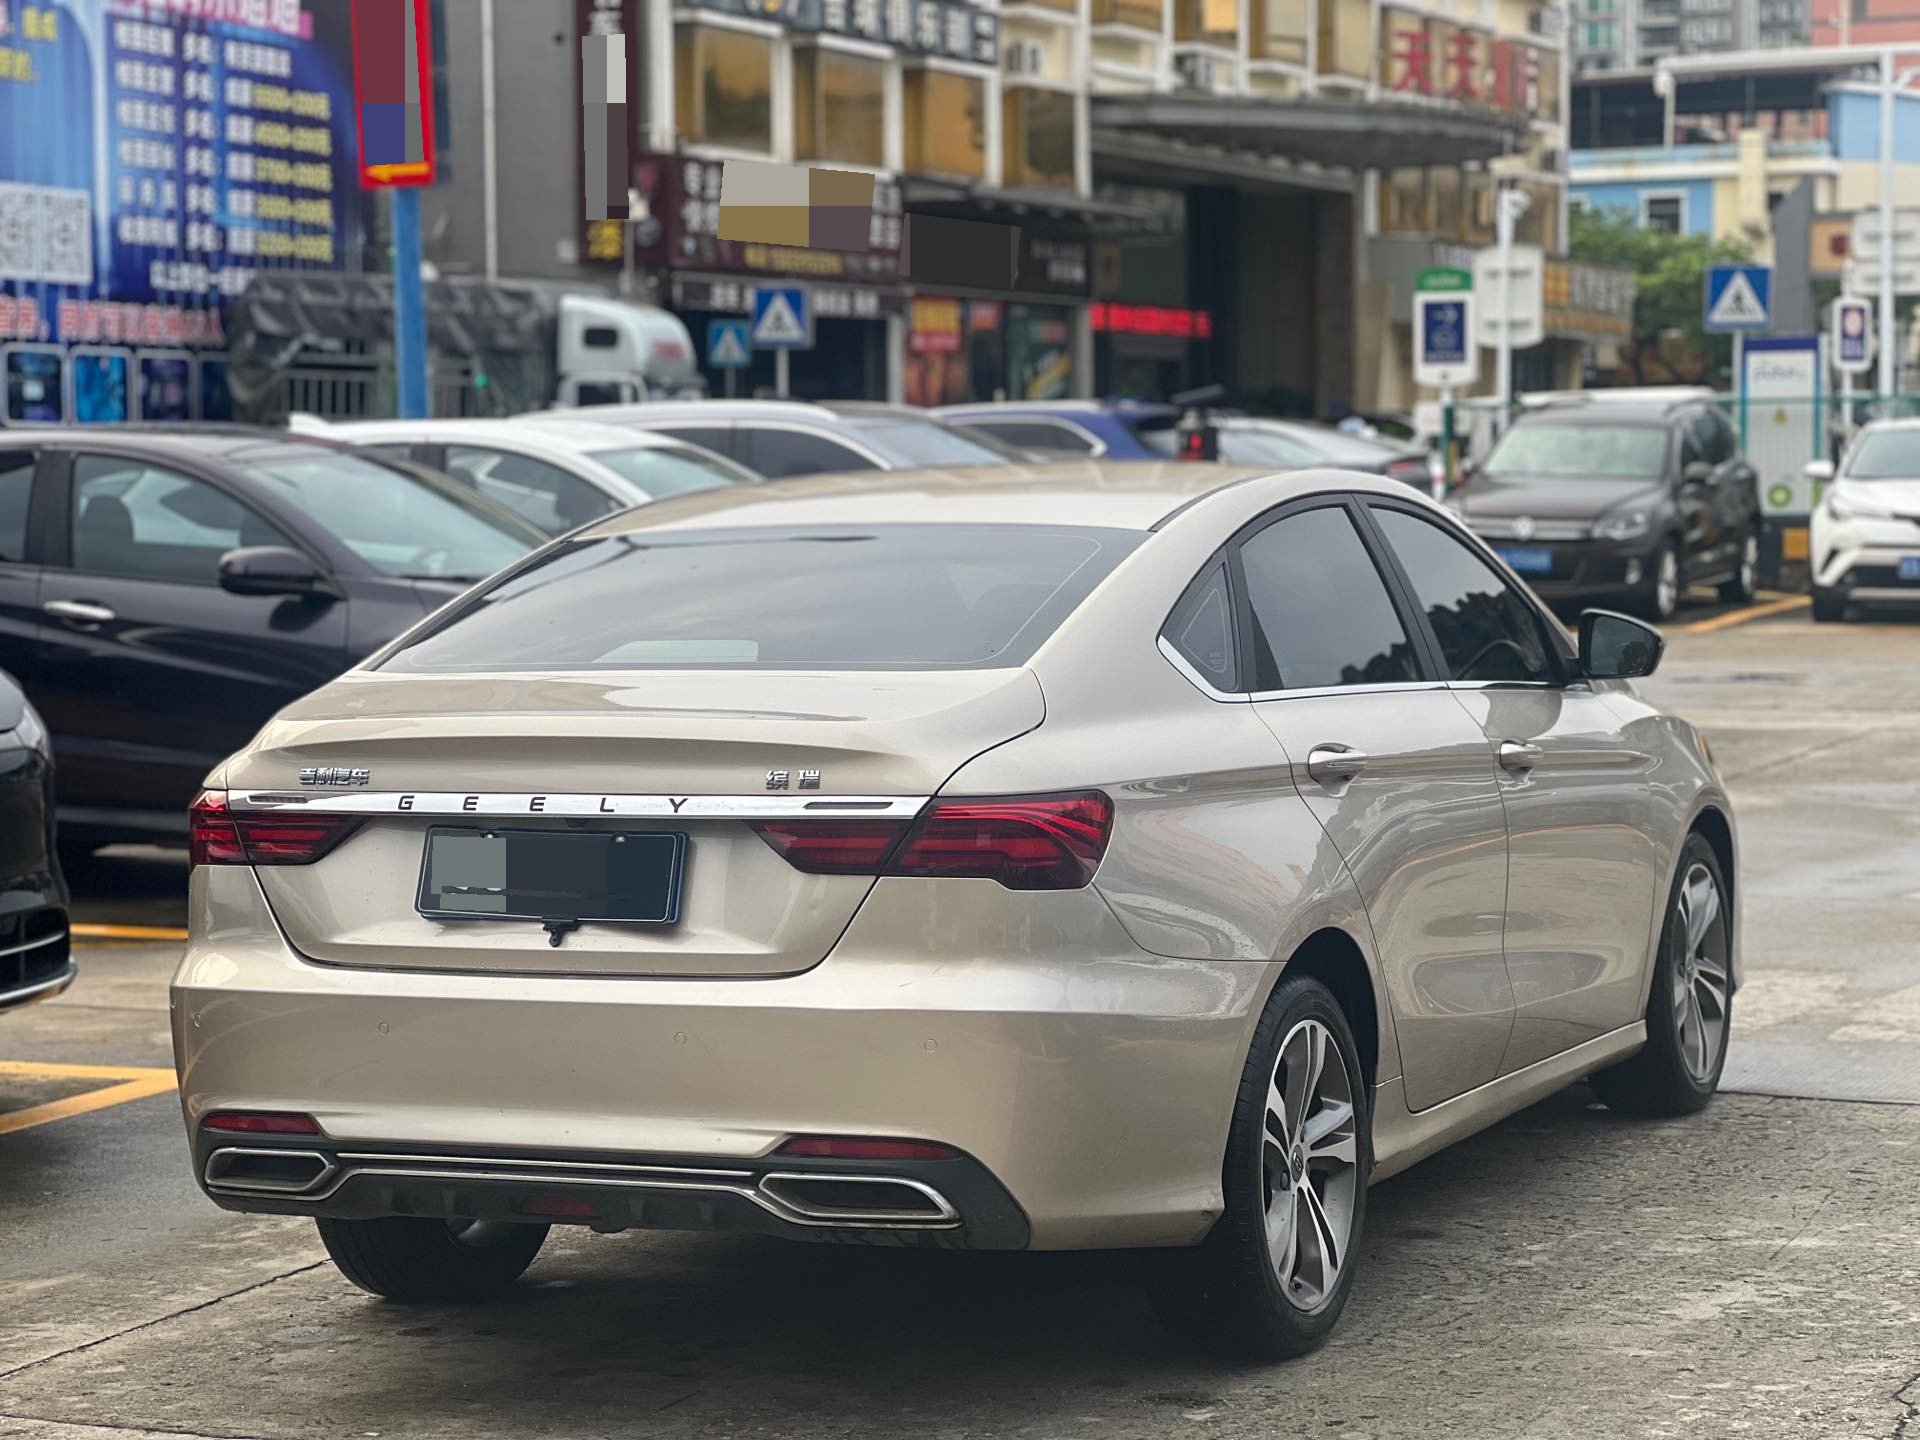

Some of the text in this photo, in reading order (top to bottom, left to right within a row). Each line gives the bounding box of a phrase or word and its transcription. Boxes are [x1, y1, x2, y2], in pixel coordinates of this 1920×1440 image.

[299, 767, 370, 787] 吉利汽车
[765, 769, 821, 790] 缤瑞
[397, 795, 689, 814] GEELY
